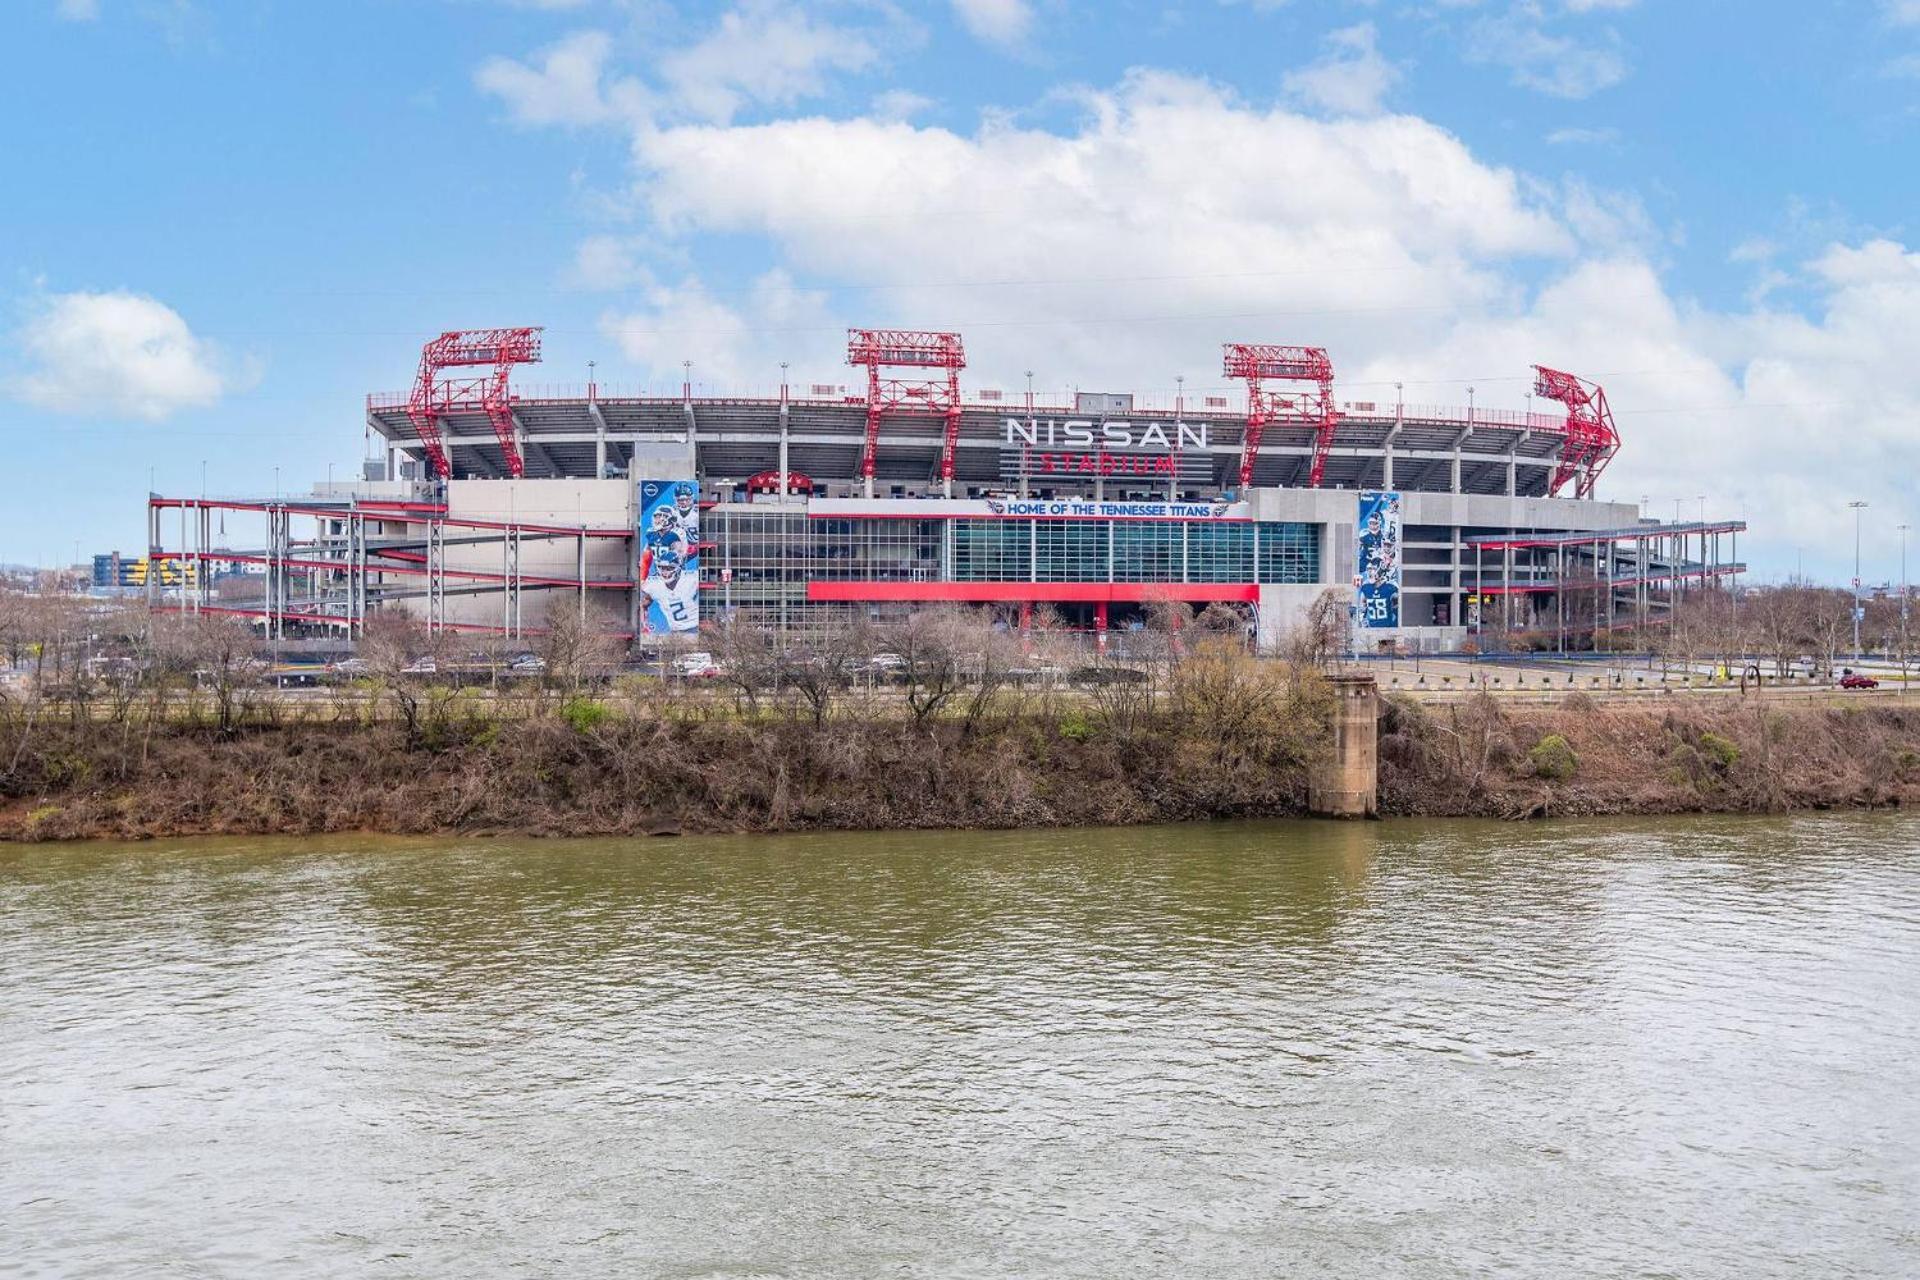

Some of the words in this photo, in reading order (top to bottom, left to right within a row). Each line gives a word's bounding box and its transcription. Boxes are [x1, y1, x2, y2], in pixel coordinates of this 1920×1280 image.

[1006, 418, 1207, 448] NISSAN
[1041, 453, 1175, 475] STADIUM
[1008, 504, 1046, 515] HOME
[1050, 504, 1068, 515] OF
[1072, 504, 1095, 515] THE
[1100, 504, 1166, 516] TENNESSEE
[1170, 506, 1209, 516] TITANS
[670, 601, 688, 621] 2
[1366, 598, 1387, 619] 58
